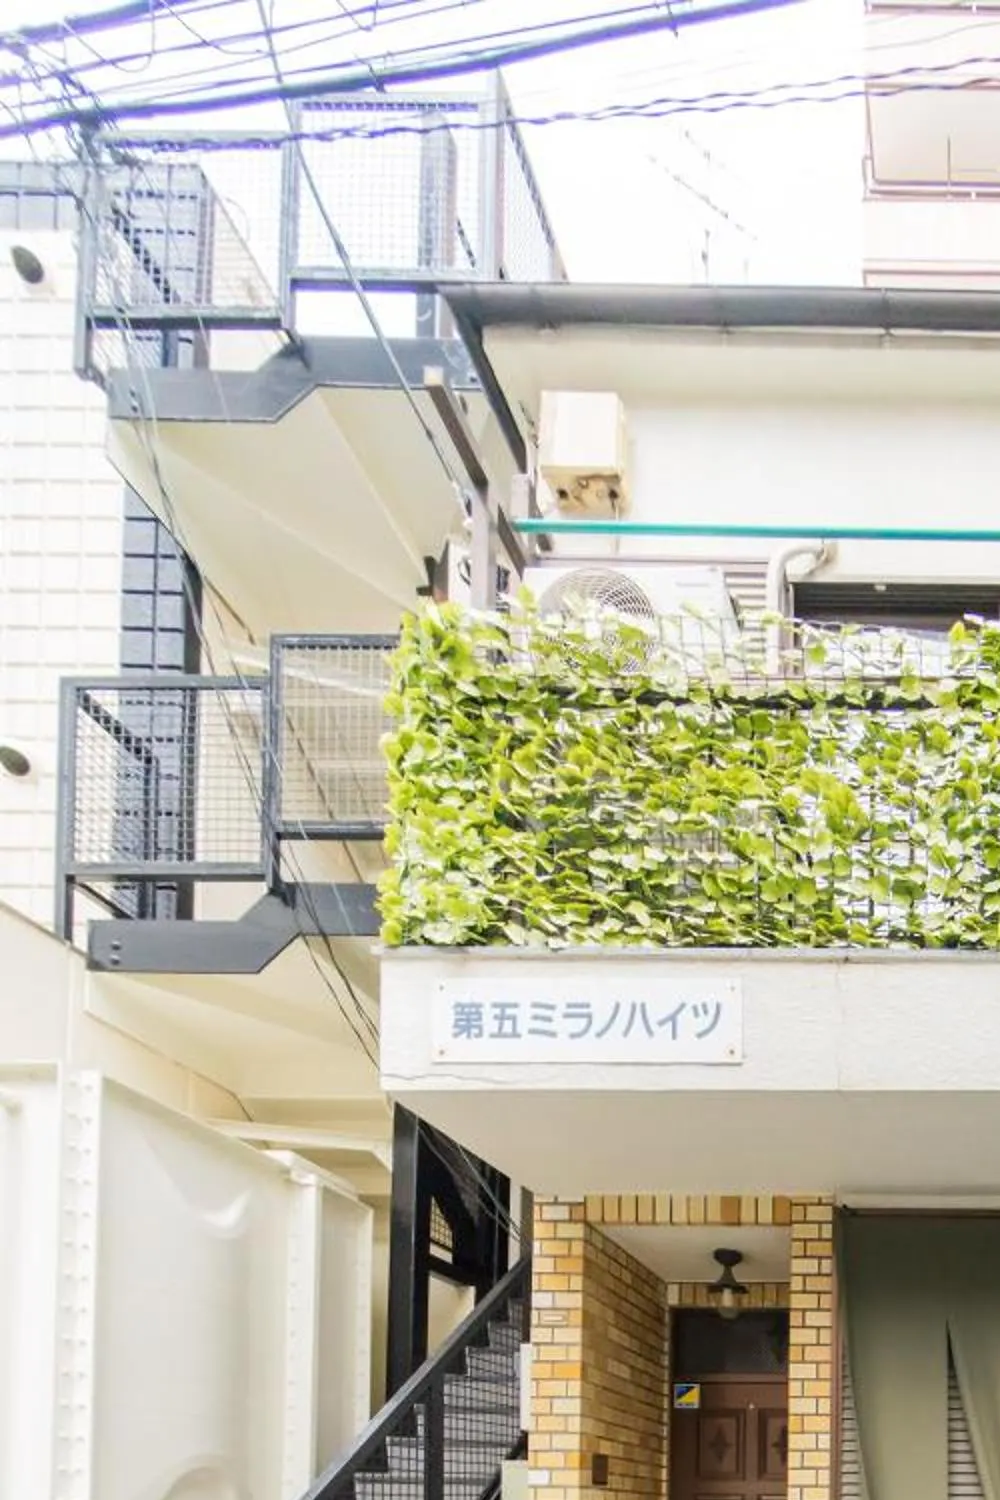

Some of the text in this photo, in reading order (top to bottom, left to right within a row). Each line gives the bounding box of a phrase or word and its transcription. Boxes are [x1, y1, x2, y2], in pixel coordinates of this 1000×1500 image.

[452, 1001, 722, 1041] 第五ミラノハイツ
